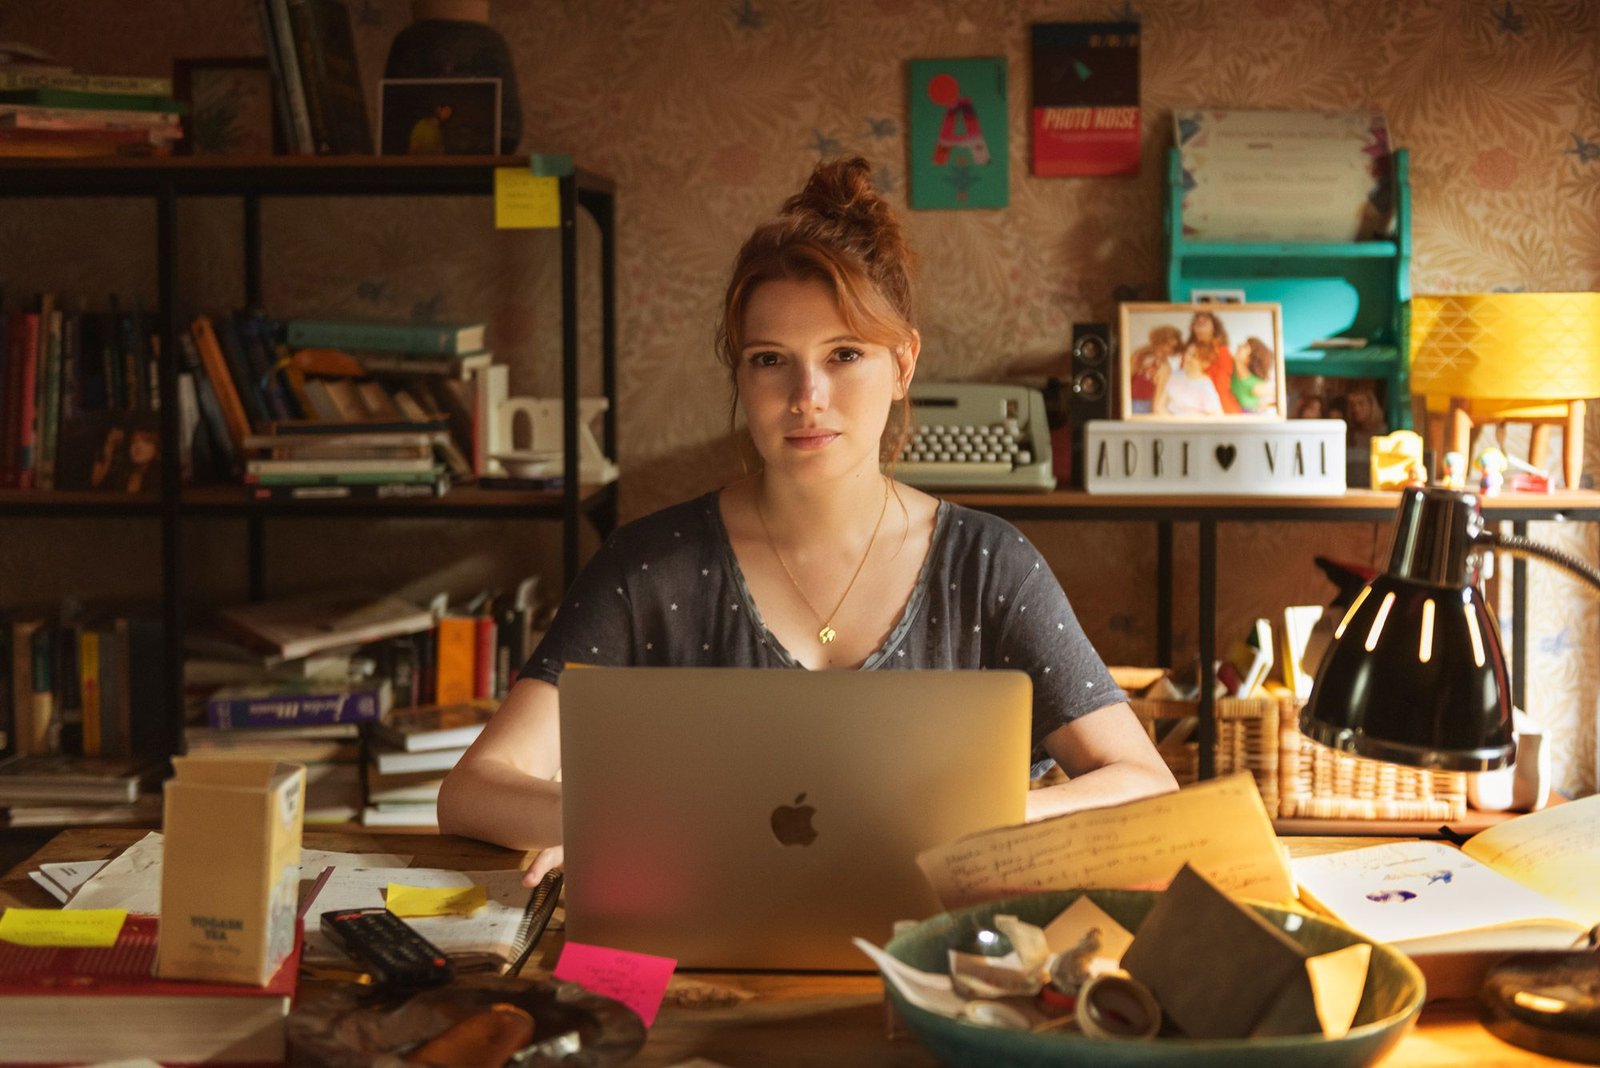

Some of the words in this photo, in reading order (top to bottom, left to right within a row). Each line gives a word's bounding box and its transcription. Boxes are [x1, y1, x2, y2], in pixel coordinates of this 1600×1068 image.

[1041, 107, 1092, 129] PHOTO
[1095, 107, 1139, 128] NOISE
[1097, 439, 1190, 477] ADRI
[205, 929, 227, 941] TEA
